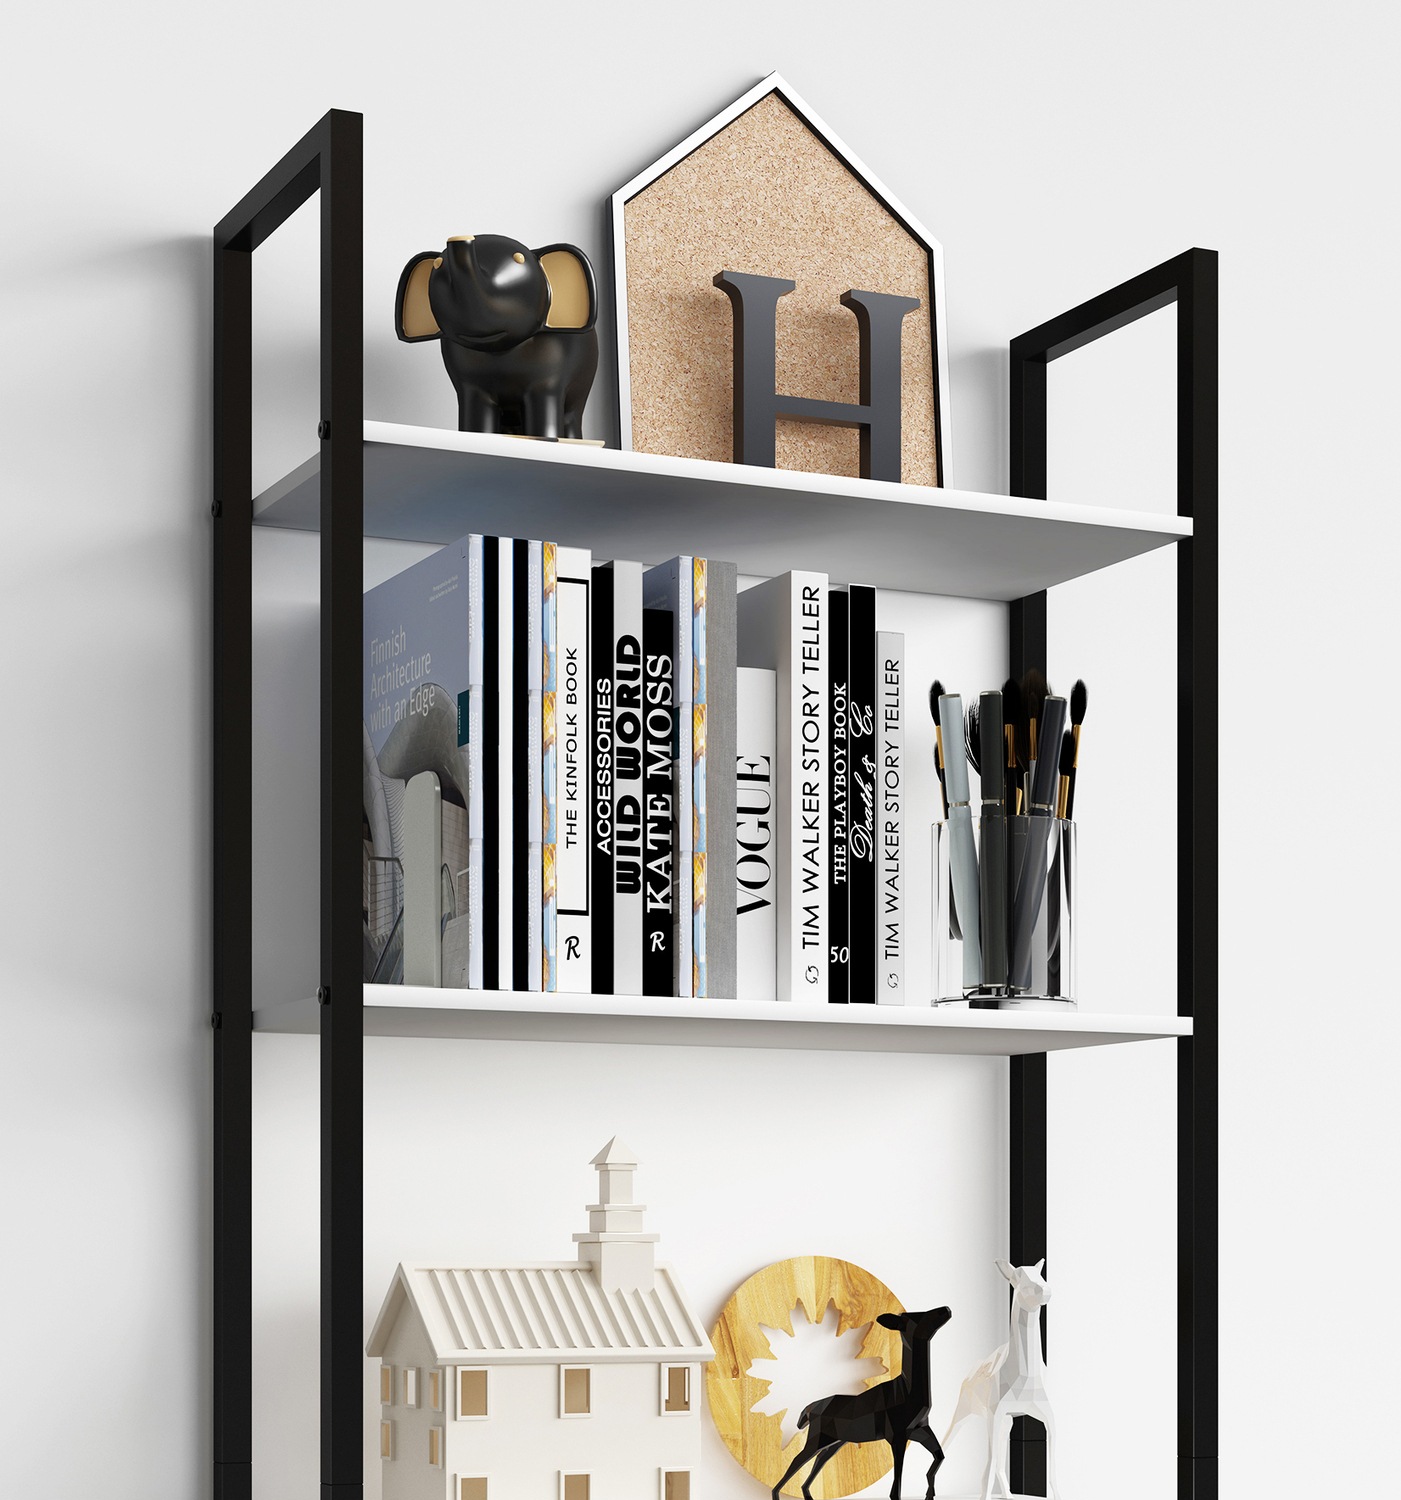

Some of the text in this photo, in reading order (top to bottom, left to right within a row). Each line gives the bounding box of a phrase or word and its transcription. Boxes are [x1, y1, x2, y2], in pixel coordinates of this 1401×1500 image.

[712, 269, 919, 482] H
[370, 625, 406, 667] Finnish
[370, 652, 432, 700] Architecture
[370, 684, 435, 733] with an Edge
[849, 702, 873, 738] Co
[566, 648, 577, 849] THE KINFOLK BOOK
[597, 678, 611, 855] ACCESSORIES
[616, 634, 641, 894] WILD WORLD
[647, 655, 673, 914] KATE MOSS
[736, 755, 772, 915] VOGUE
[802, 586, 820, 950] TIM WALKER STORY TELLER
[834, 682, 847, 885] THE PLAYBOY BOOK
[850, 771, 874, 863] Death
[885, 659, 900, 960] TIM WALKER STORY TELLER
[830, 946, 849, 963] 50
